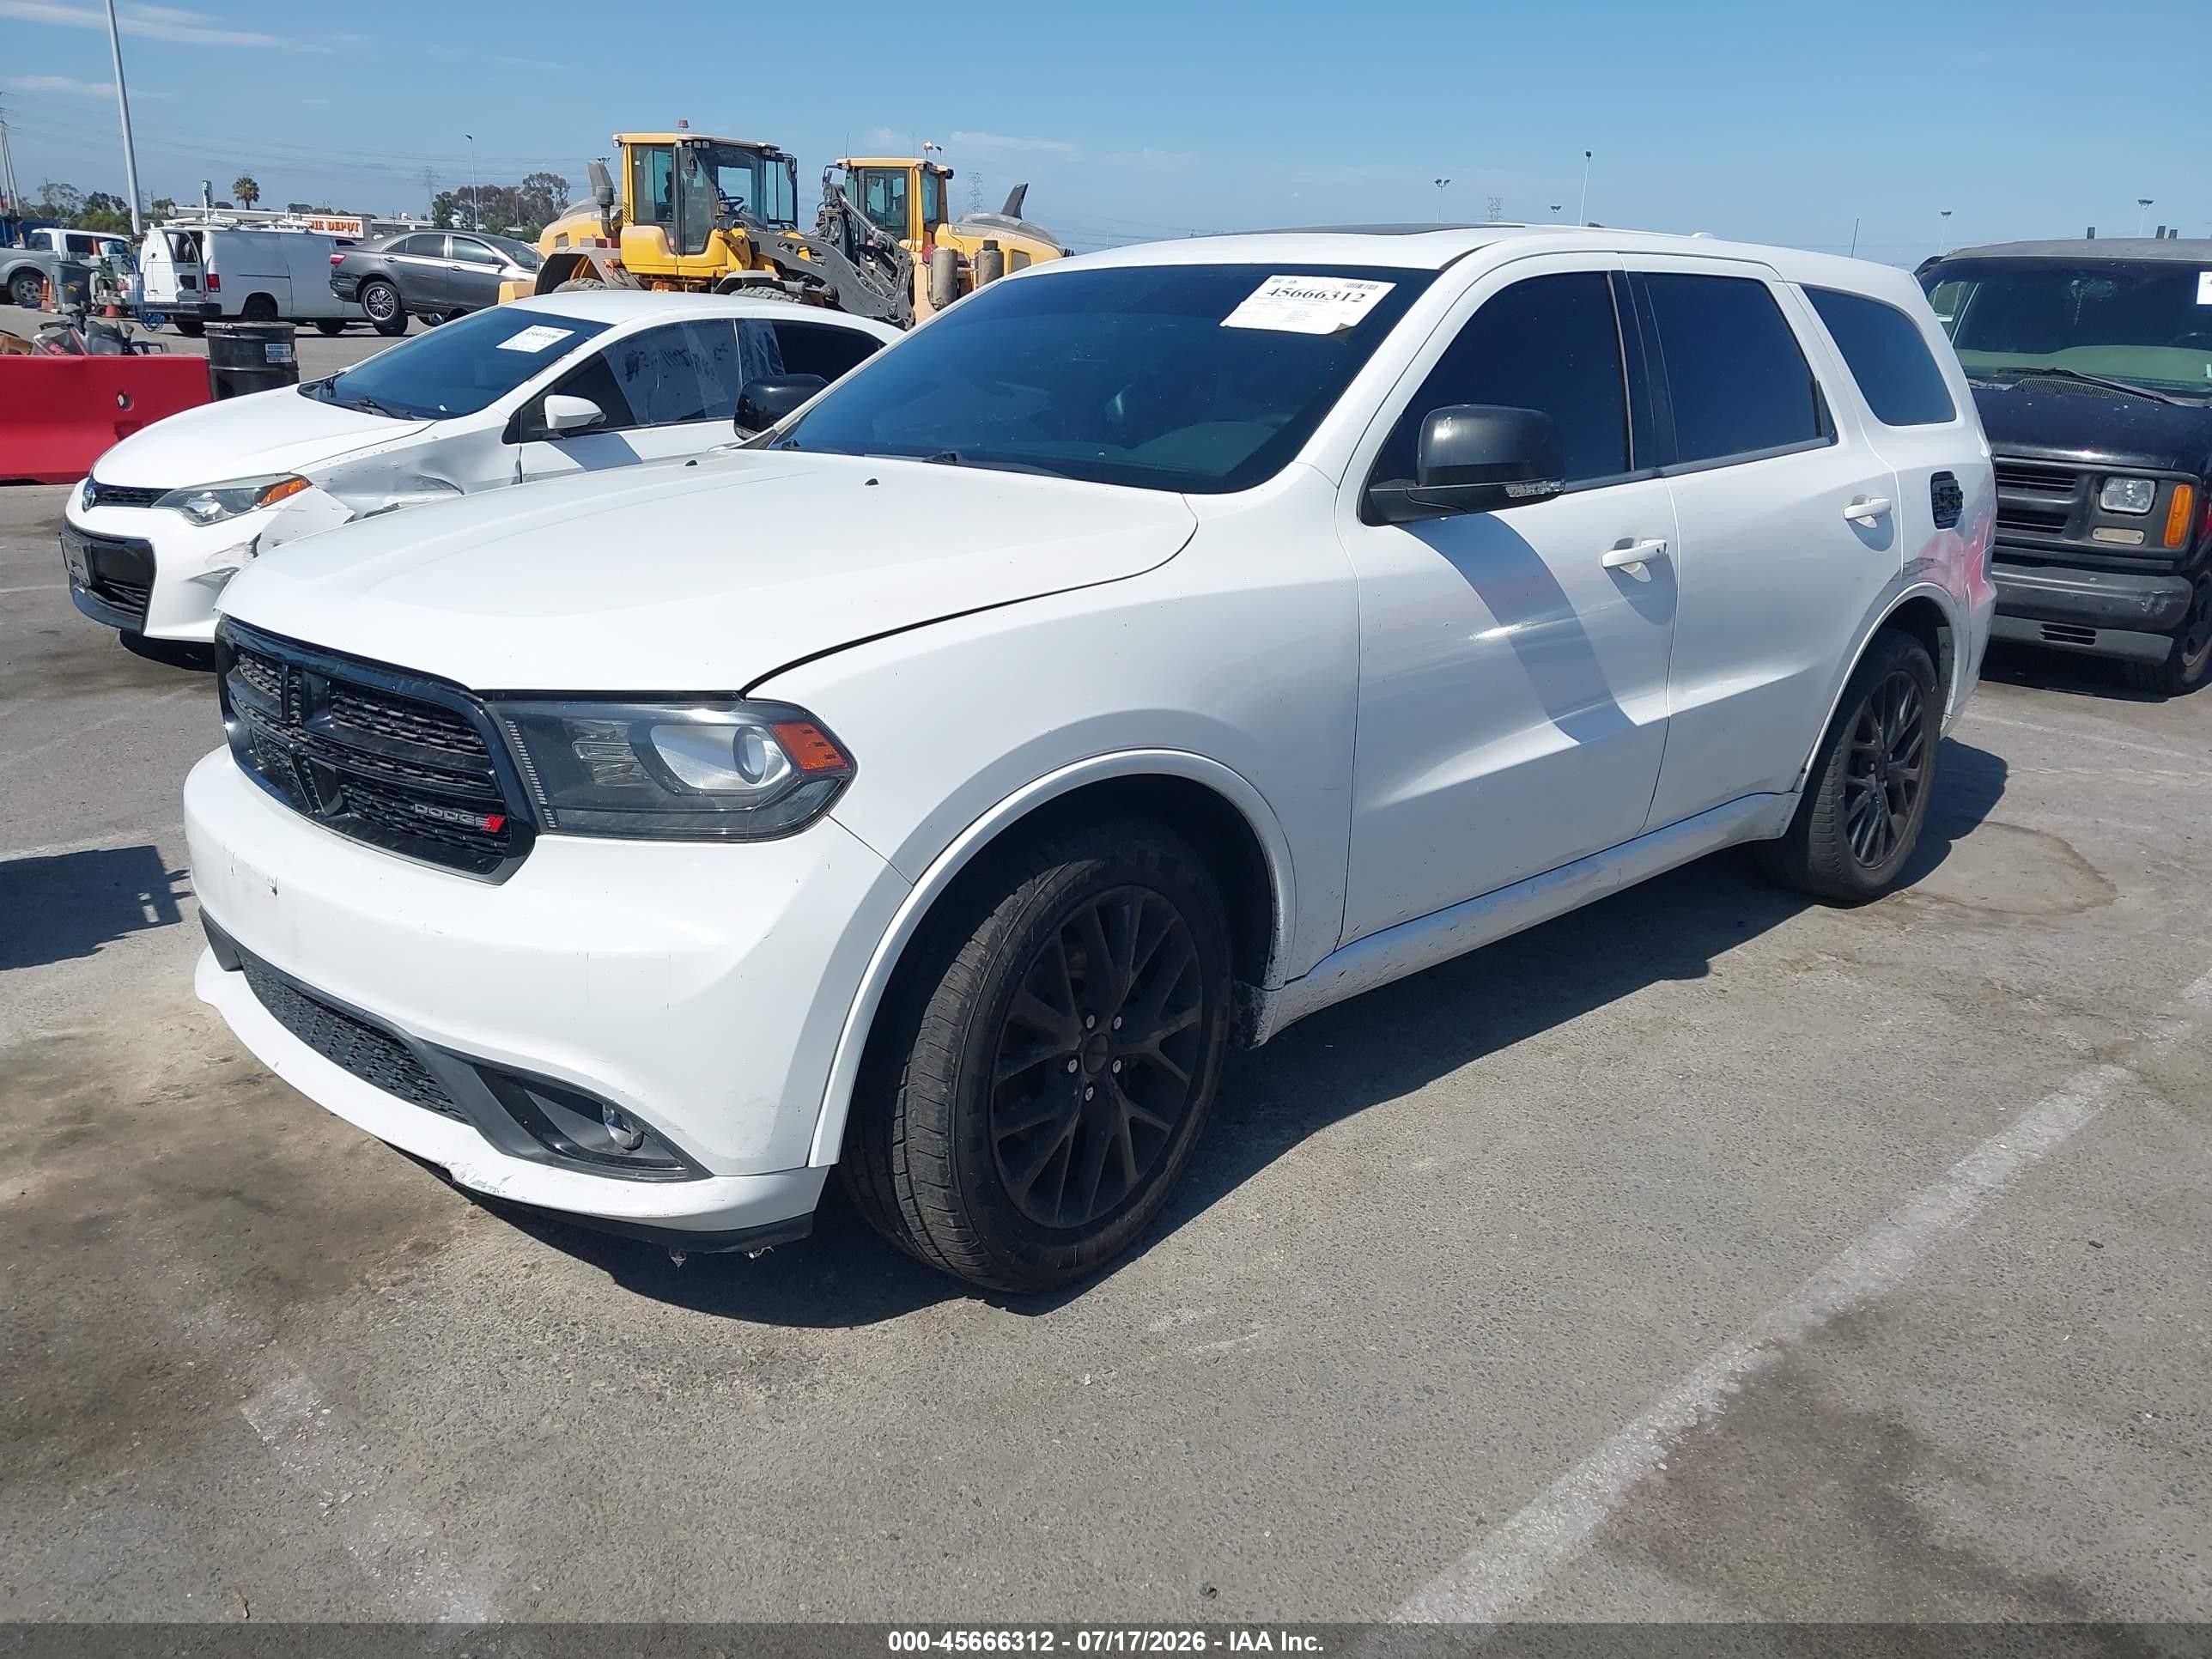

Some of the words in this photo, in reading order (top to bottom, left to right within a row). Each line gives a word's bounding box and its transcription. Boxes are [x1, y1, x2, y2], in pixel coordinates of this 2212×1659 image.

[328, 221, 359, 232] DEPOT
[1267, 288, 1365, 302] 45666312
[414, 803, 490, 826] DODGE
